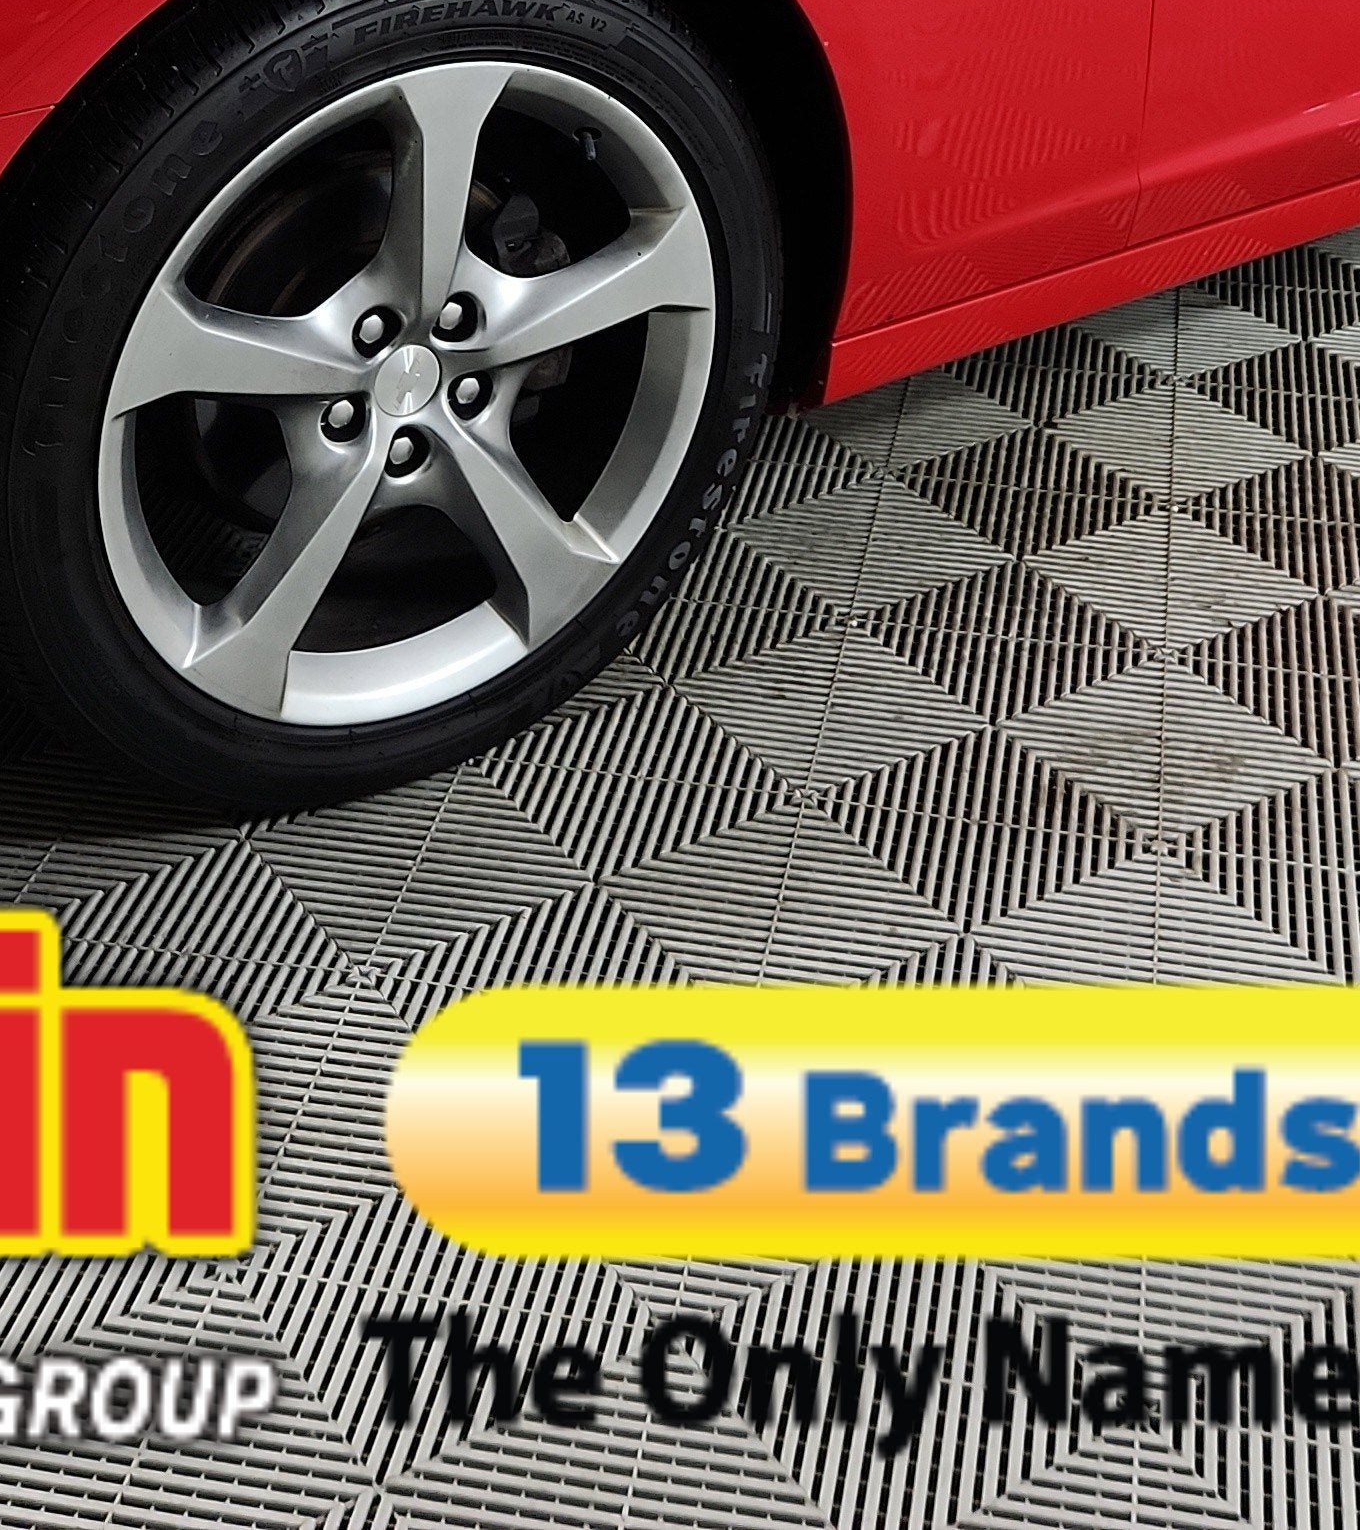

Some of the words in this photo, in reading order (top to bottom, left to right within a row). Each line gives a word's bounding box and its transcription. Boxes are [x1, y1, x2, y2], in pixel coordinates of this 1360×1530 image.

[353, 0, 567, 46] FIREHAWK
[566, 9, 584, 25] AS
[589, 15, 608, 33] V2
[615, 351, 771, 640] Firestone
